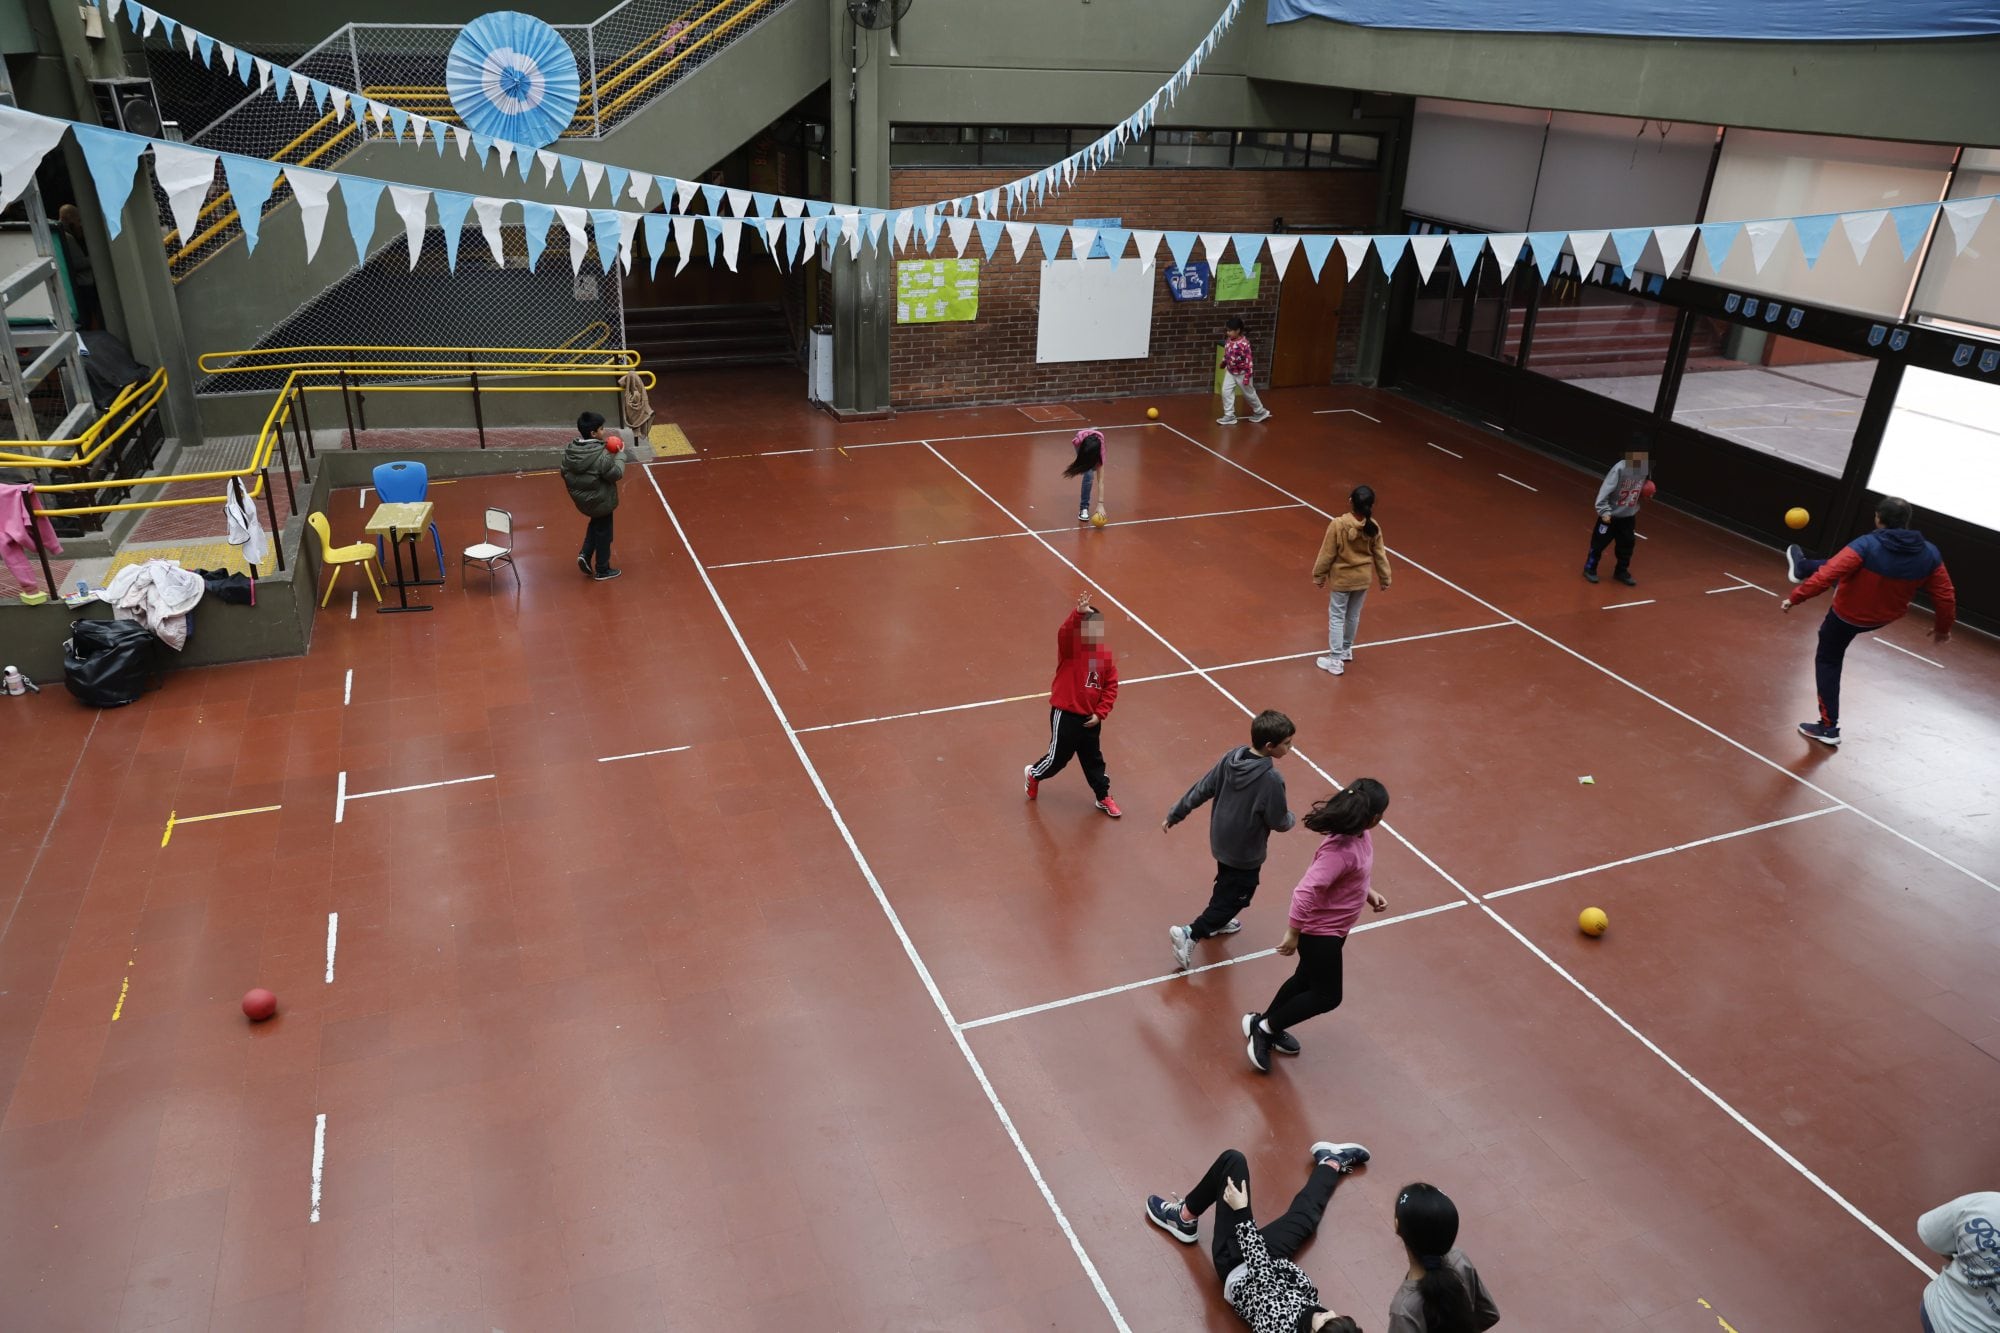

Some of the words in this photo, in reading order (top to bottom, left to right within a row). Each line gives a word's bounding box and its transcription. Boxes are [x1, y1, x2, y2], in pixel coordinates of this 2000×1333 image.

[1728, 298, 1800, 326] VIVA
[1871, 329, 1904, 348] LA
[1616, 489, 1640, 508] 23
[1085, 668, 1102, 689] A
